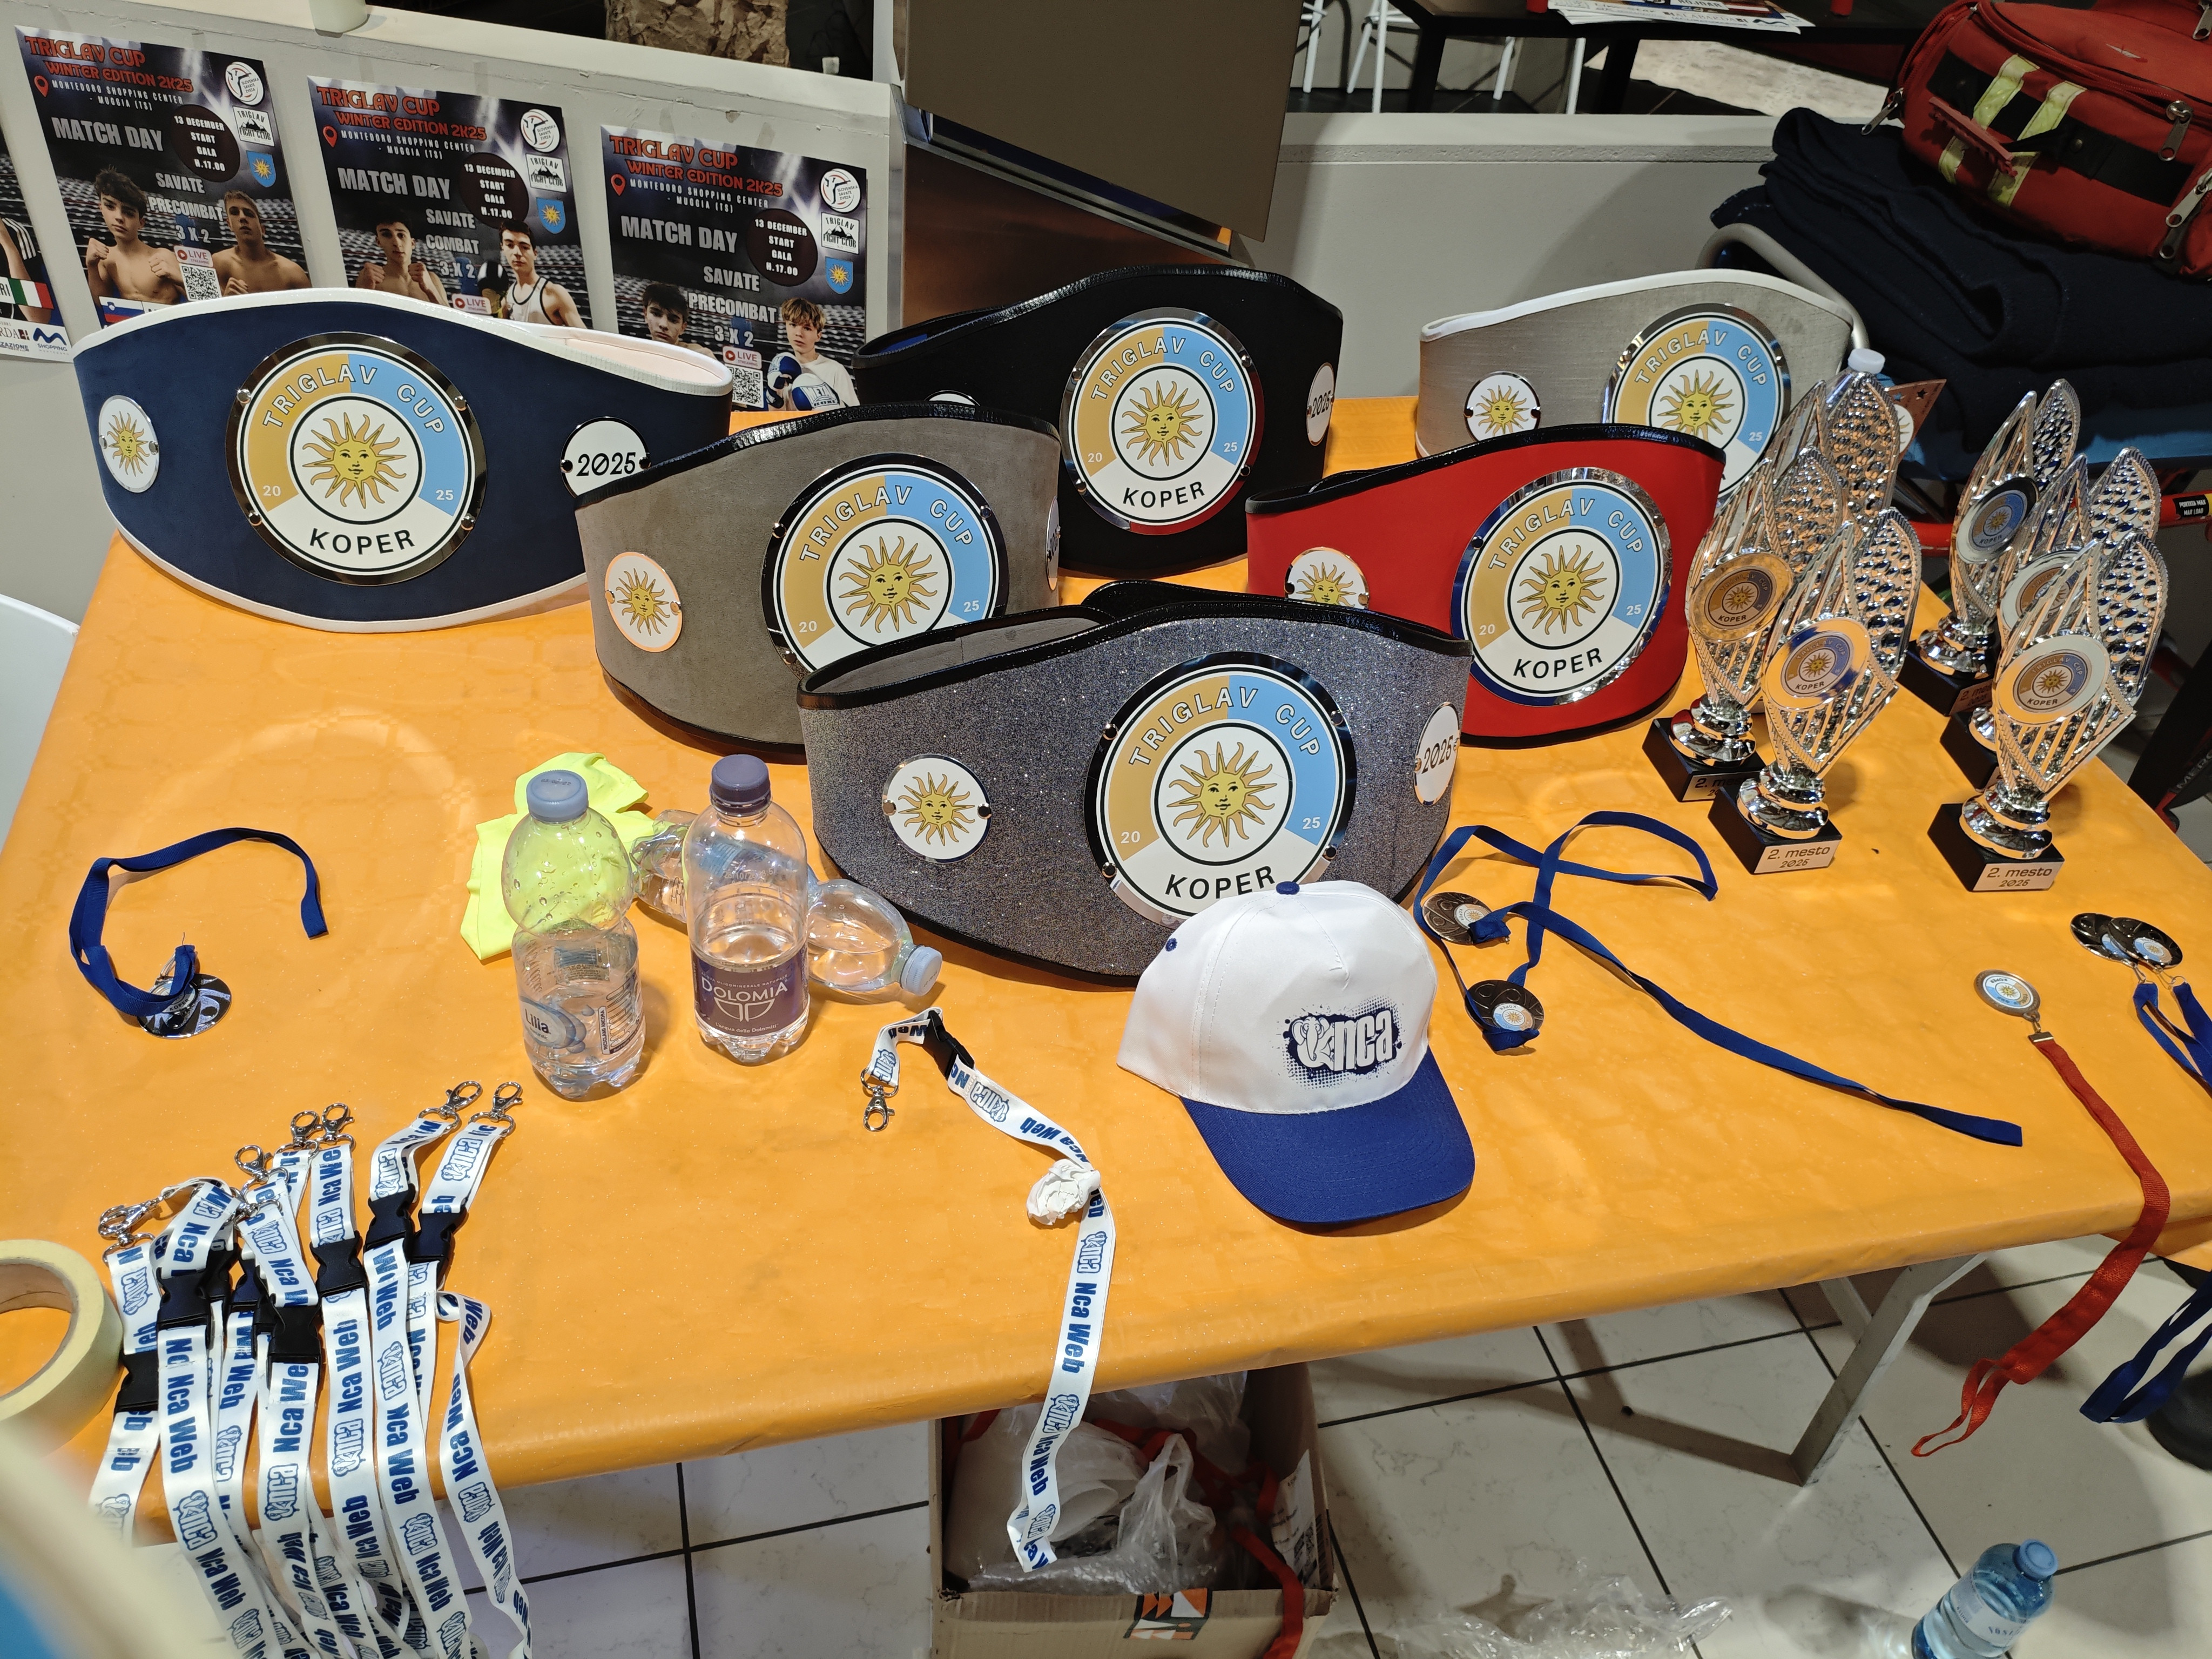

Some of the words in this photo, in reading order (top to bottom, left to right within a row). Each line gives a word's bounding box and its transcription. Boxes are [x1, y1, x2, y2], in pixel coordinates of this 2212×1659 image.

[25, 36, 105, 63] TRIGLAV
[109, 46, 146, 68] CUP
[45, 60, 100, 79] WINTER
[103, 68, 156, 87] EDITION
[158, 75, 194, 92] 2K25
[52, 80, 102, 95] MONTEDORO
[106, 85, 149, 100] SHOPPING
[153, 91, 184, 105] CENTER
[98, 96, 131, 109] MUGGIA
[316, 86, 398, 112] TRIGLAV
[402, 97, 440, 116] CUP
[174, 116, 184, 124] 13
[186, 117, 225, 131] DECEMBER
[237, 110, 265, 123] TRIGLAV
[334, 111, 390, 127] WINTER
[393, 118, 448, 135] EDITION
[451, 124, 487, 140] 2K25
[51, 117, 123, 146] MATCH
[127, 126, 164, 151] DAY
[191, 132, 215, 144] START
[239, 127, 256, 138] FIGHT
[257, 131, 271, 140] CLUB
[341, 131, 391, 144] MONTEDORO
[397, 136, 439, 148] SHOPPING
[444, 141, 475, 153] CENTER
[197, 145, 217, 157] GALA
[609, 136, 694, 163] TRIGLAV
[699, 147, 738, 170] CUP
[194, 159, 225, 172] H.17.00
[465, 164, 474, 172] 13
[477, 165, 516, 178] DECEMBER
[156, 172, 205, 193] SAVATE
[338, 167, 408, 195] MATCH
[413, 176, 450, 200] DAY
[480, 180, 504, 191] START
[626, 160, 683, 179] WINTER
[686, 168, 743, 190] EDITION
[746, 178, 784, 197] 2K25
[485, 193, 504, 205] GALA
[630, 179, 682, 194] MONTEDORO
[688, 187, 731, 202] SHOPPING
[737, 195, 768, 208] CENTER
[676, 195, 710, 210] MUGGIA
[715, 202, 733, 213] (TS)
[149, 195, 225, 222] PRECOMBAT
[426, 208, 476, 229] SAVATE
[481, 206, 512, 219] H.17.00
[621, 215, 692, 246] MATCH
[699, 227, 738, 253] DAY
[755, 219, 765, 228] 13
[767, 220, 807, 236] DECEMBER
[825, 217, 854, 230] TRIGLAV
[426, 234, 479, 255] COMBAT
[769, 236, 794, 248] START
[824, 234, 840, 244] FIGHT
[841, 238, 856, 247] CLUB
[188, 250, 208, 260] LIVE
[772, 250, 792, 262] GALA
[703, 266, 760, 292] SAVATE
[766, 262, 798, 276] H.17.00
[467, 298, 486, 308] LIVE
[688, 293, 777, 323] PRECOMBAT
[714, 326, 725, 341] 3
[743, 331, 754, 348] 2
[738, 352, 757, 362] LIVE
[1634, 329, 1727, 384] TRIGLAV
[1737, 345, 1766, 387] CUP
[1090, 336, 1186, 402] TRIGLAV
[1199, 350, 1235, 394] CUP
[262, 364, 379, 429] TRIGLAV
[396, 383, 445, 436] CUP
[1311, 390, 1331, 419] 2025
[1223, 441, 1238, 453] 25
[1748, 431, 1763, 442] 25
[576, 452, 636, 476] 2025
[1087, 452, 1103, 463] 20
[262, 485, 281, 497] 20
[435, 489, 454, 501] 25
[1122, 480, 1205, 509] KOPER
[798, 484, 912, 563] TRIGLAV
[929, 499, 974, 547] CUP
[1488, 498, 1595, 570] TRIGLAV
[1608, 510, 1644, 554] CUP
[308, 529, 415, 555] KOPER
[1758, 577, 1767, 591] CUP
[963, 601, 980, 612] 25
[1626, 605, 1642, 616] 25
[799, 621, 818, 633] 20
[1479, 624, 1496, 636] 20
[1513, 648, 1603, 679] KOPER
[2032, 657, 2071, 673] TRIGLAV
[2073, 662, 2083, 675] CUP
[1795, 682, 1824, 690] KOPER
[2027, 698, 2058, 706] KOPER
[1129, 686, 1258, 767] TRIGLAV
[1274, 703, 1320, 758] CUP
[1421, 735, 1453, 774] 2025
[1302, 817, 1321, 831] 25
[1120, 831, 1141, 844] 20
[1767, 849, 1780, 860] 2.
[1785, 847, 1830, 858] mesto
[1779, 859, 1809, 868] 2025
[1164, 865, 1276, 900] KOPER
[1987, 868, 2000, 878] 2.
[2005, 867, 2052, 877] mesto
[702, 976, 787, 1002] DOLOMIA
[762, 974, 788, 986] NATURALE
[170, 999, 190, 1011] KOPER
[525, 1009, 550, 1034] Lilia
[716, 1022, 735, 1031] L'acqua
[752, 1023, 777, 1033] Dolomiti
[1333, 1010, 1393, 1072] nca
[1020, 1117, 1061, 1140] Web
[1060, 1135, 1089, 1163] Nca
[173, 1222, 211, 1263] Nca
[1070, 1283, 1097, 1318] Nca
[463, 1298, 483, 1345] Web
[333, 1319, 361, 1372] Web
[1062, 1324, 1093, 1373] Web
[167, 1373, 194, 1415] Nca
[338, 1372, 362, 1414] Nca
[272, 1407, 305, 1453] Nca
[387, 1402, 409, 1447] Nca
[168, 1417, 198, 1473] Web
[388, 1449, 420, 1505] Web
[478, 1521, 507, 1559] Web
[195, 1547, 228, 1578] Nca
[211, 1573, 246, 1610] Web
